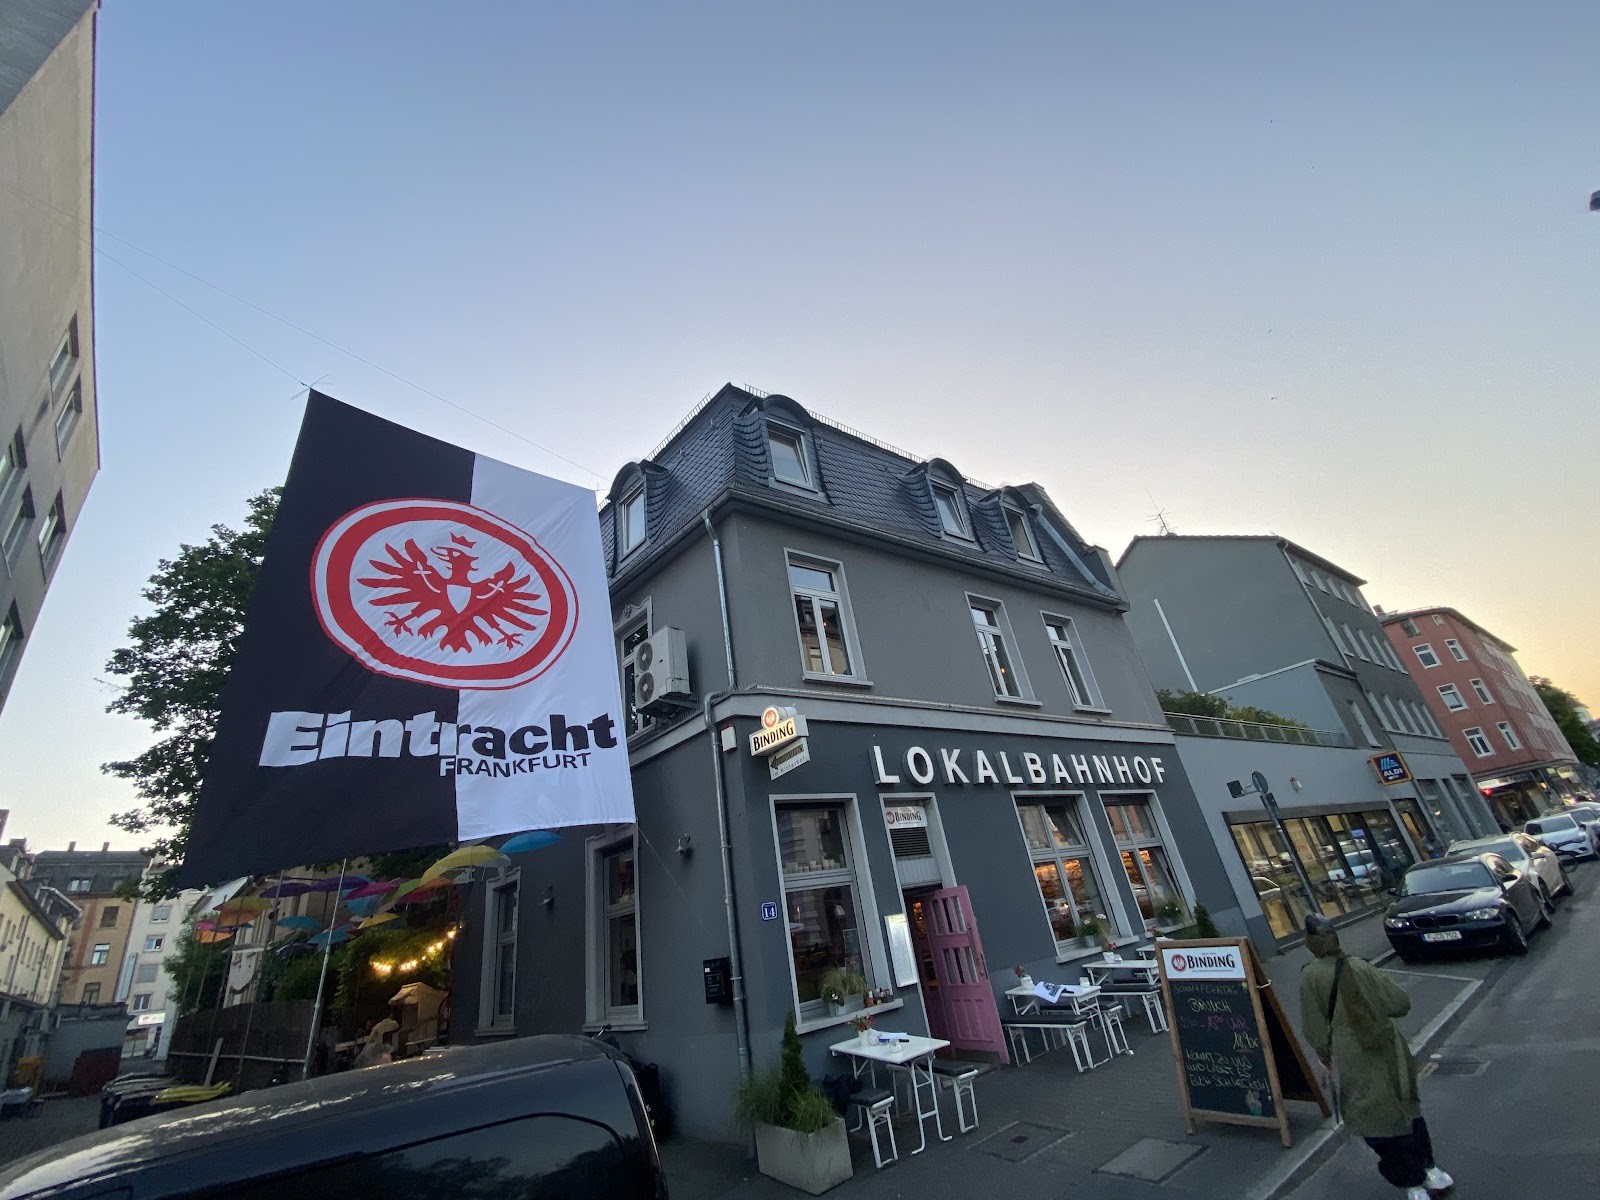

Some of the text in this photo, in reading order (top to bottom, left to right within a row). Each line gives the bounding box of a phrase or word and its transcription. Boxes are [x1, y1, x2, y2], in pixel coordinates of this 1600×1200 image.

[259, 710, 617, 767] Eintracht
[753, 721, 794, 752] BINDING
[439, 752, 592, 778] FRANKFURT
[871, 745, 1165, 785] LOKALBAHNHOF
[1384, 768, 1403, 777] ALDI
[894, 811, 922, 822] BINDING
[764, 906, 775, 918] 14
[1186, 953, 1235, 969] BINDING
[1188, 997, 1233, 1013] BRUNCH
